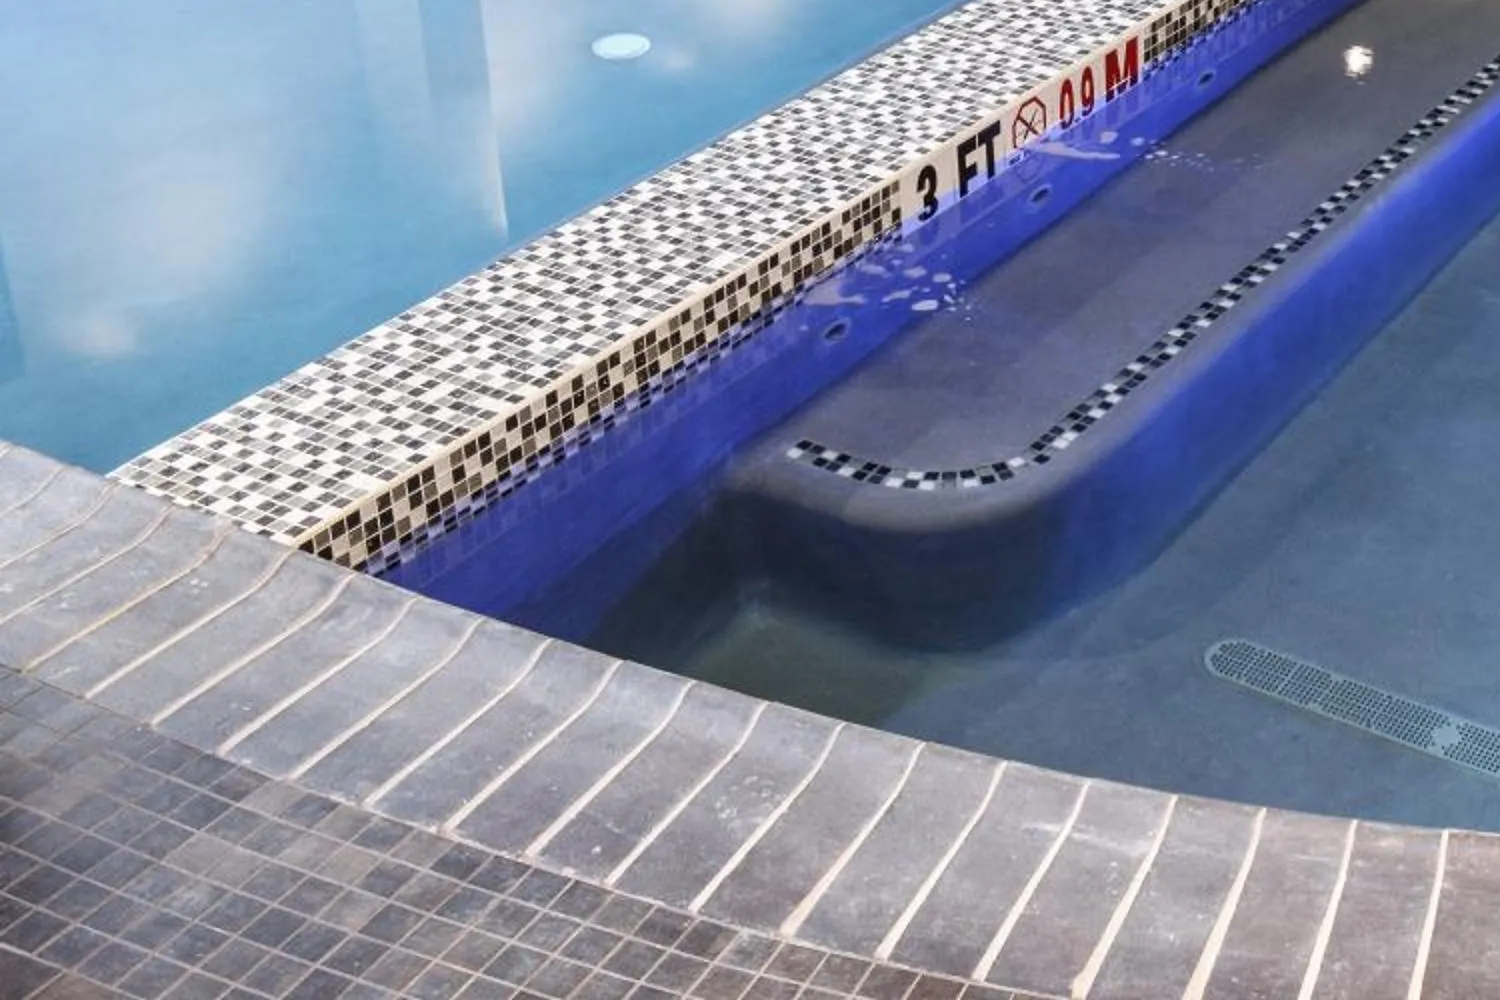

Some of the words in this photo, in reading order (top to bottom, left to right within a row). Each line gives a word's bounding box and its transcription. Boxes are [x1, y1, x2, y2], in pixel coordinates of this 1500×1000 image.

[916, 165, 938, 221] 3
[957, 120, 1001, 198] FT
[1105, 36, 1139, 102] M
